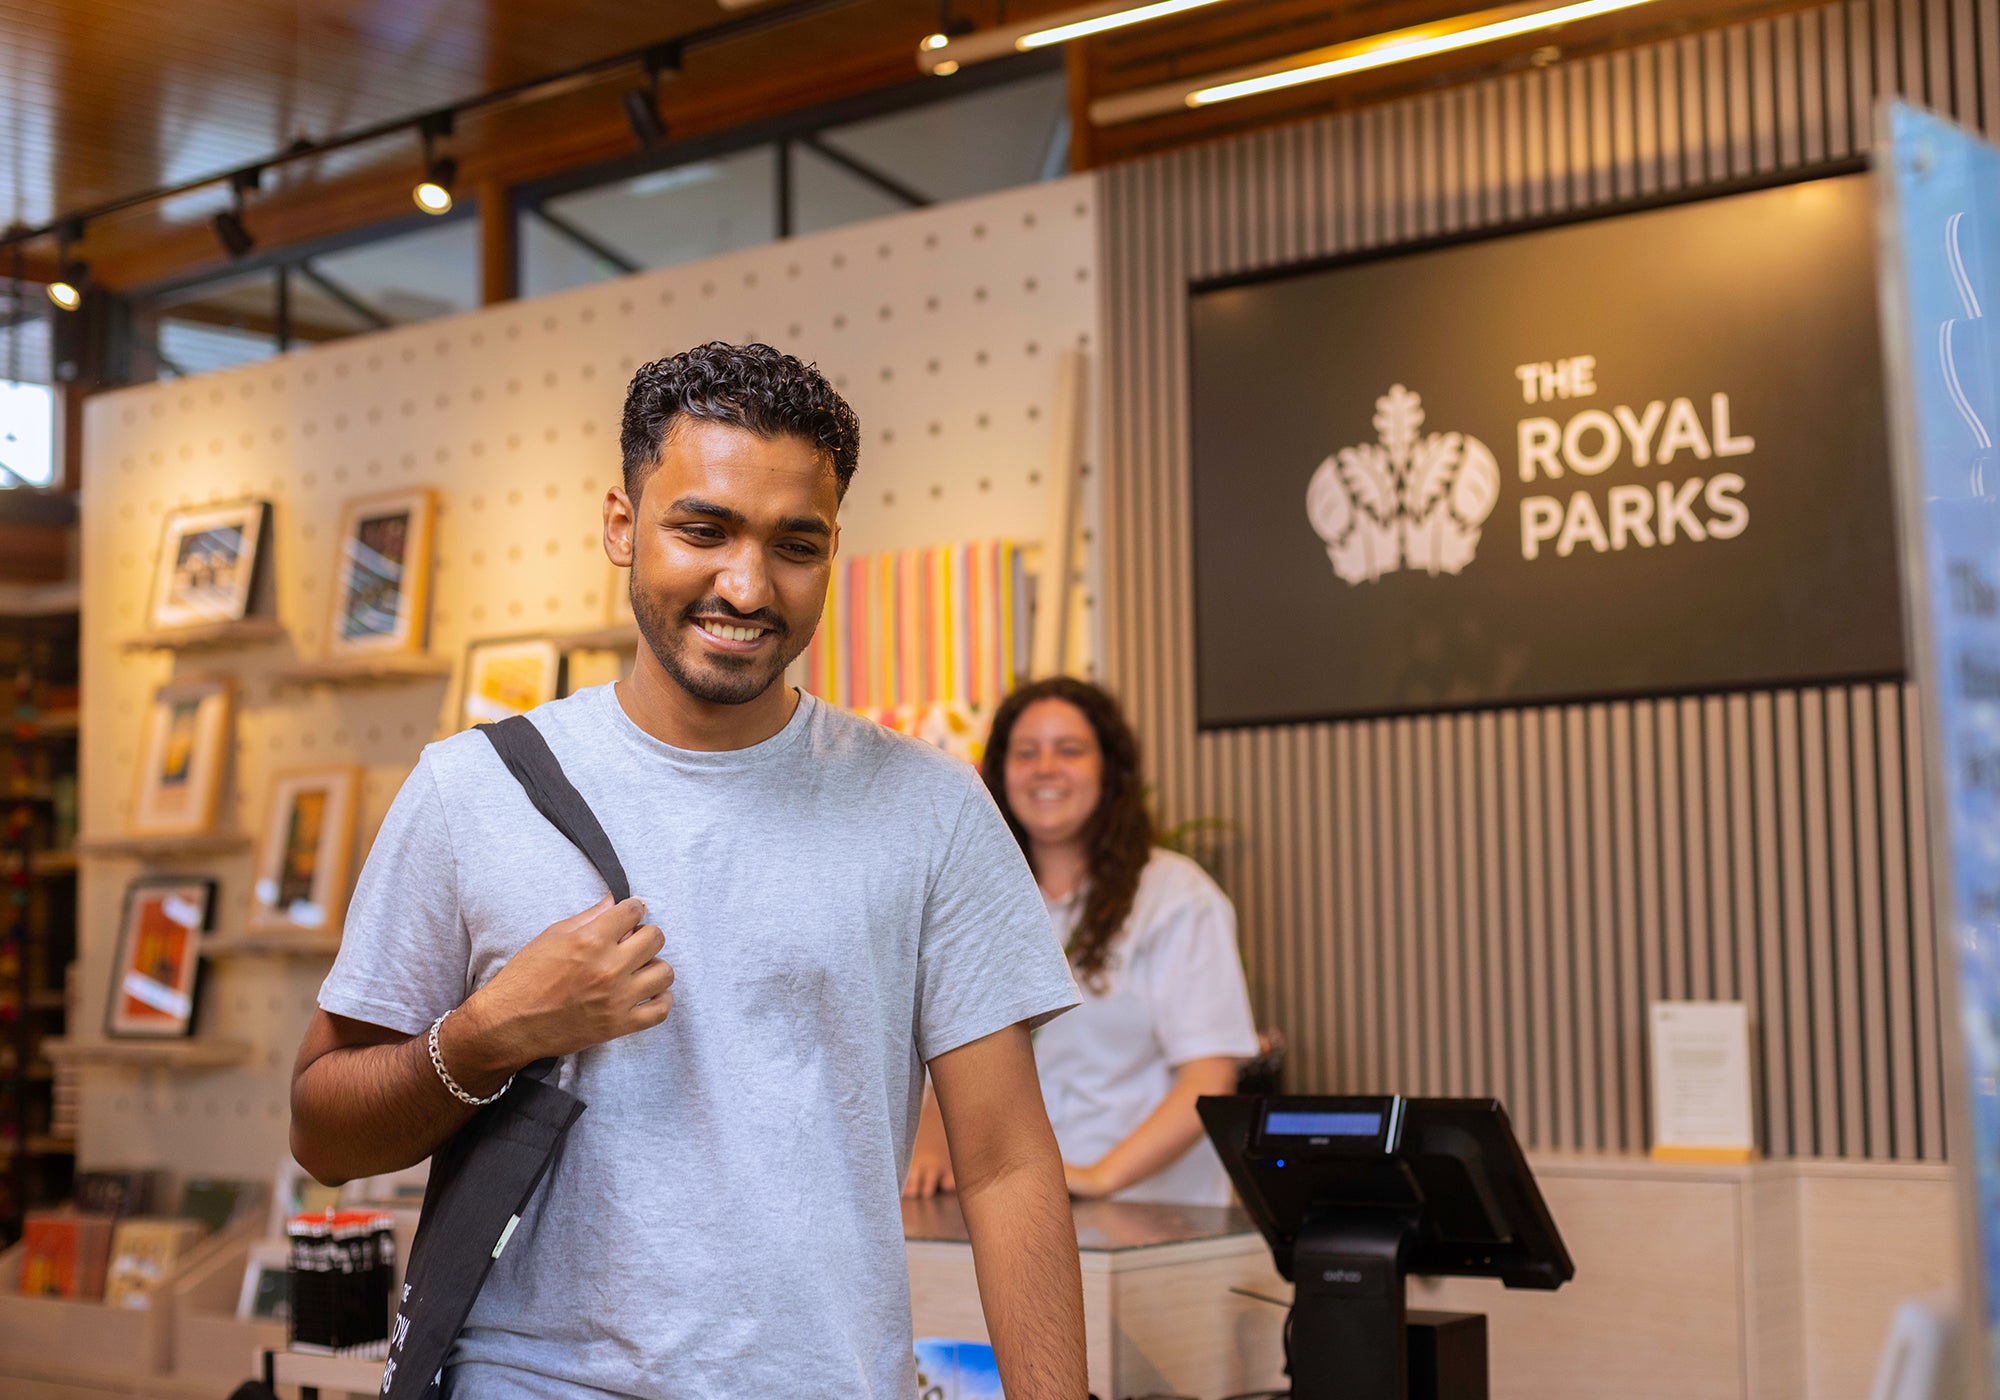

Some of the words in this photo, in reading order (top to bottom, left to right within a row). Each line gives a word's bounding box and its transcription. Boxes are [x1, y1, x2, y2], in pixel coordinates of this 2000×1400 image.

[1515, 355, 1597, 403] THE
[1517, 392, 1756, 482] ROYAL
[1519, 473, 1750, 560] PARKS
